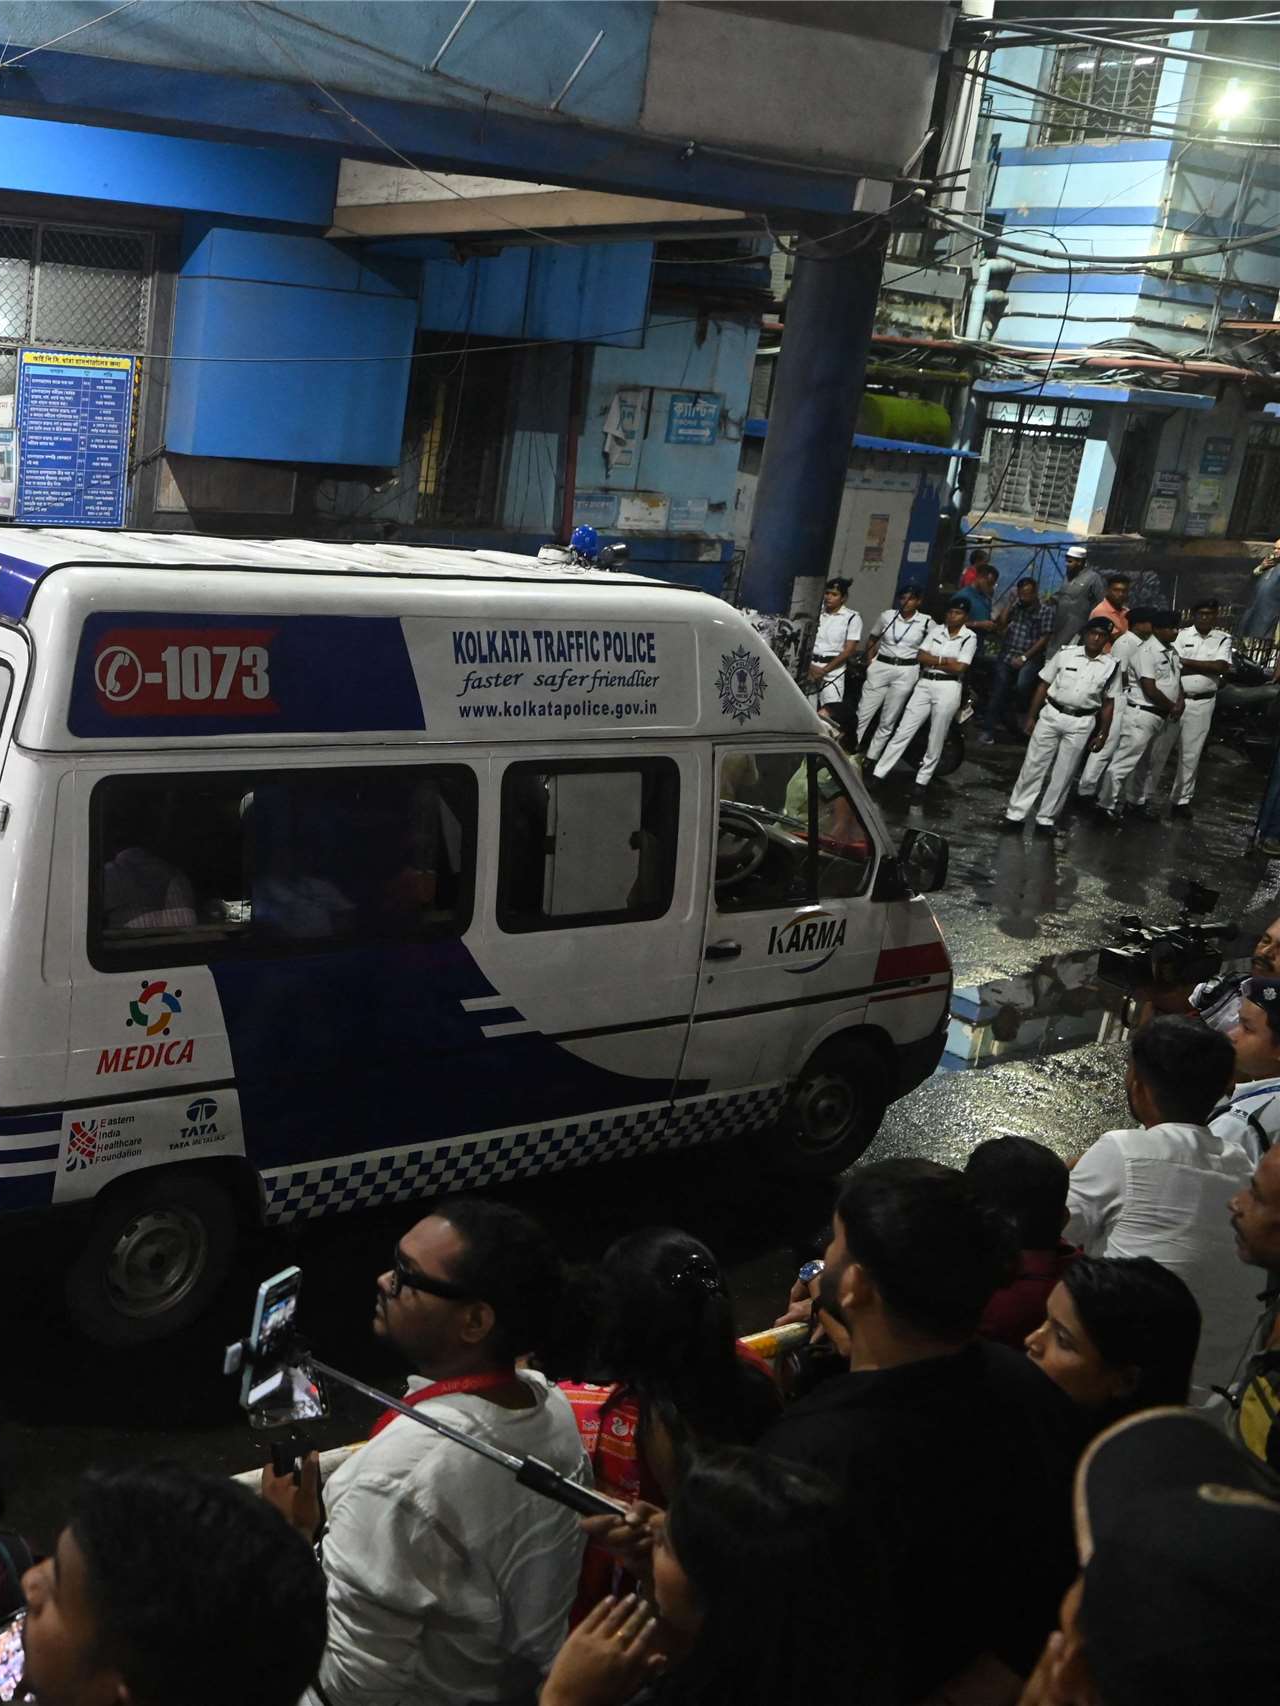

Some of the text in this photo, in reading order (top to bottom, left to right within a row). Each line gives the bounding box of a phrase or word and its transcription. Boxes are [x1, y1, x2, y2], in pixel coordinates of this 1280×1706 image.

[453, 630, 657, 665] KOLKATA TRAFFIC POLICE
[456, 668, 660, 697] faster safer friendlier
[459, 700, 657, 720] www.kolkatapolice.gov.in
[767, 918, 848, 955] KARMA
[96, 1039, 195, 1075] MEDICA
[100, 1115, 135, 1128] Eastern
[99, 1130, 121, 1140] India
[180, 1123, 218, 1139] TATA
[97, 1138, 142, 1152] Healthcare
[169, 1142, 190, 1151] TATA
[95, 1148, 142, 1164] Foundation
